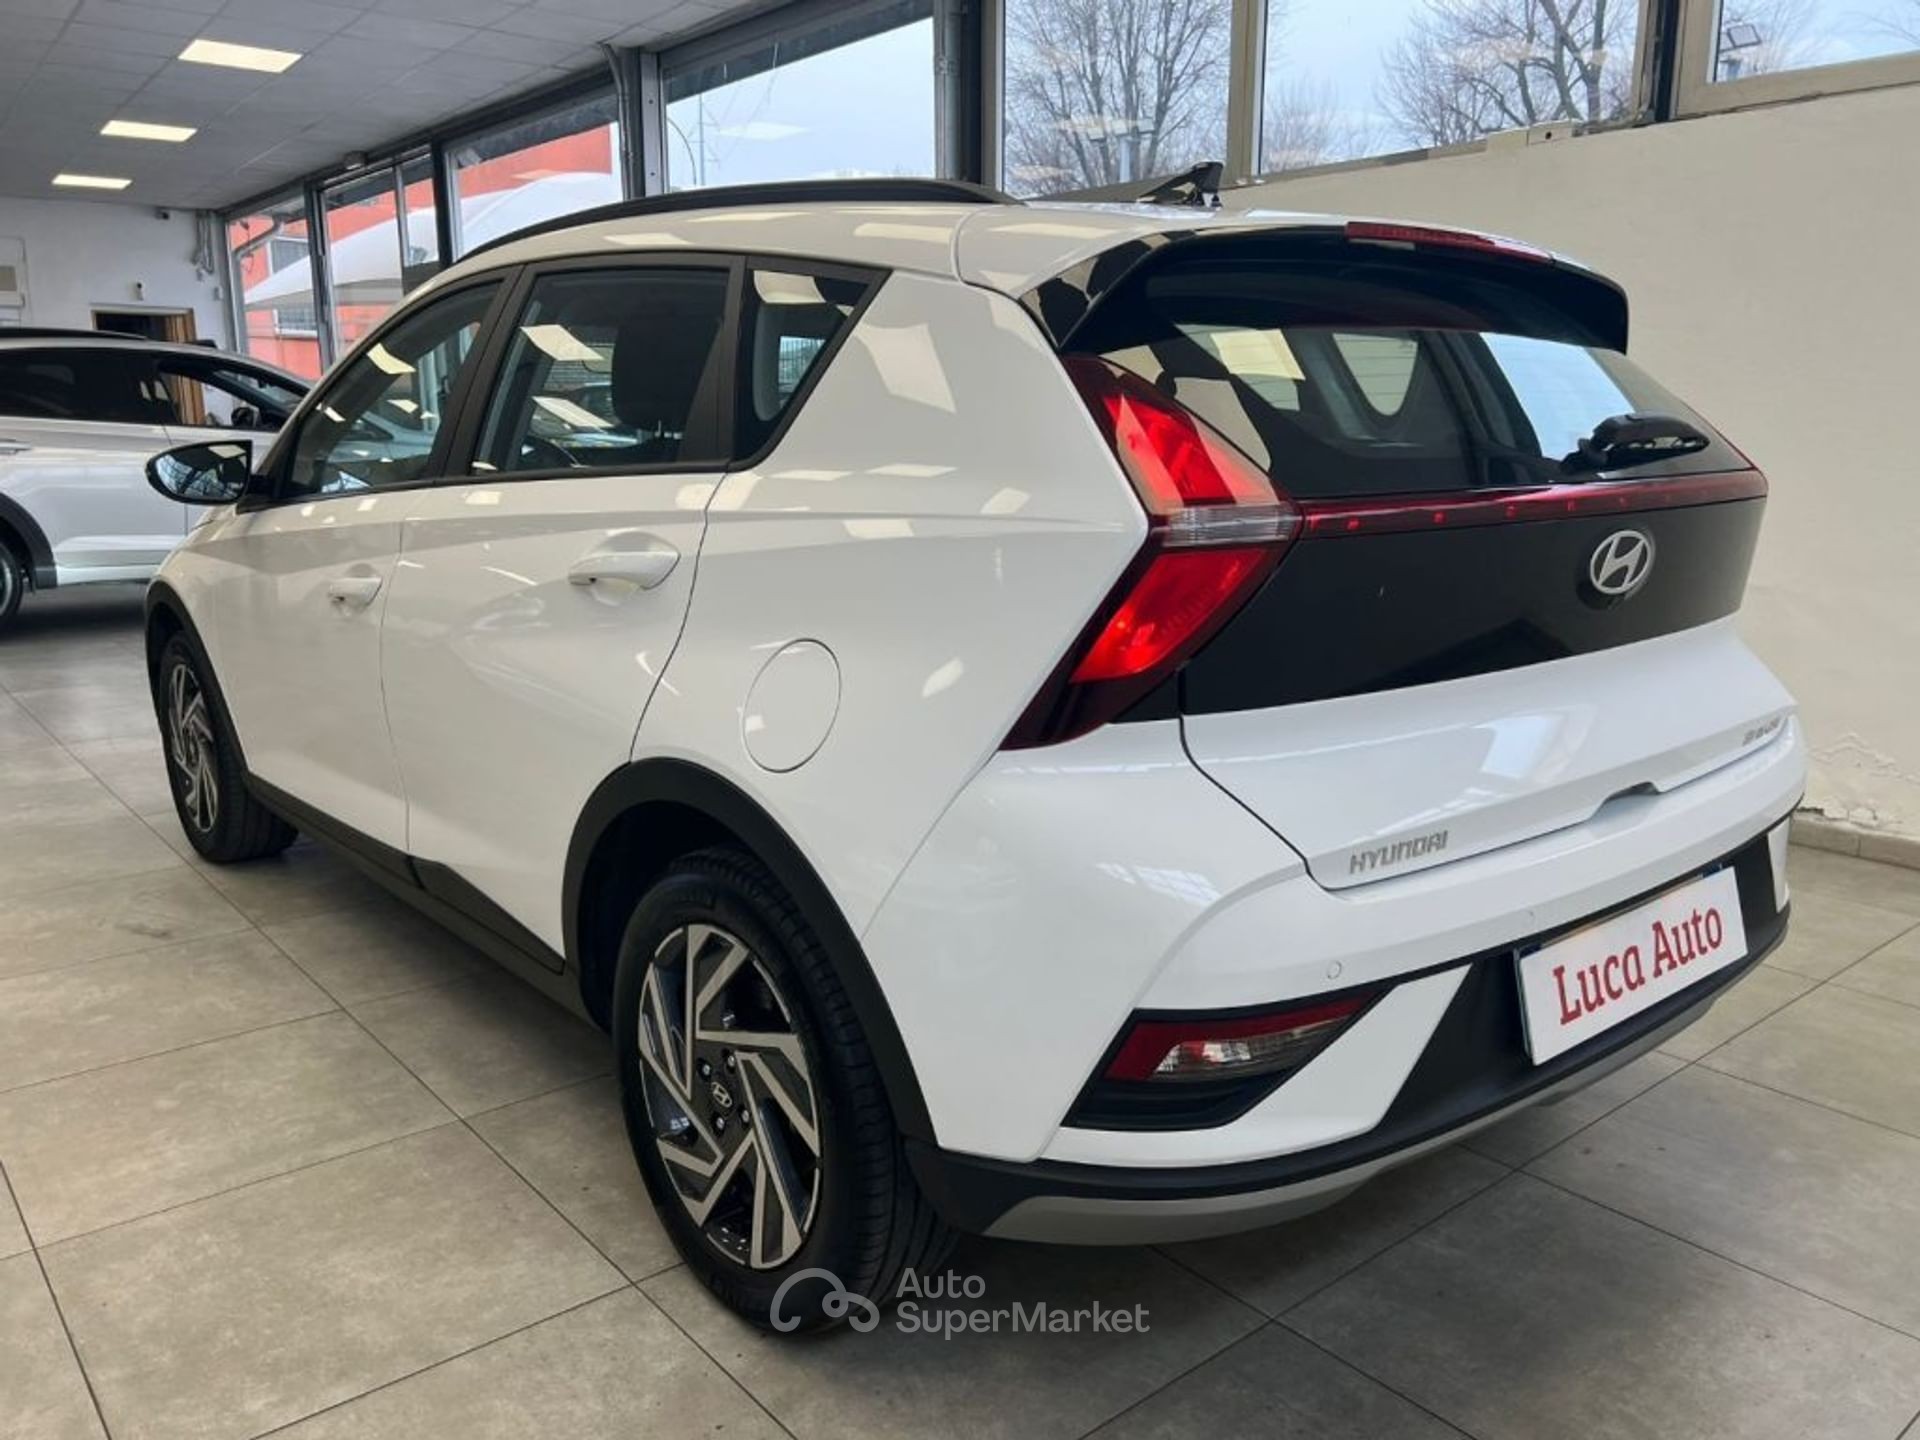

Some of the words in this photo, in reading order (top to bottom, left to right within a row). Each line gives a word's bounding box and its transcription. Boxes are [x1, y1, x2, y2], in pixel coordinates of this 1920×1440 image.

[1349, 829, 1449, 875] HYUNDAI
[1553, 944, 1646, 1026] Luca
[1652, 907, 1723, 979] Auto
